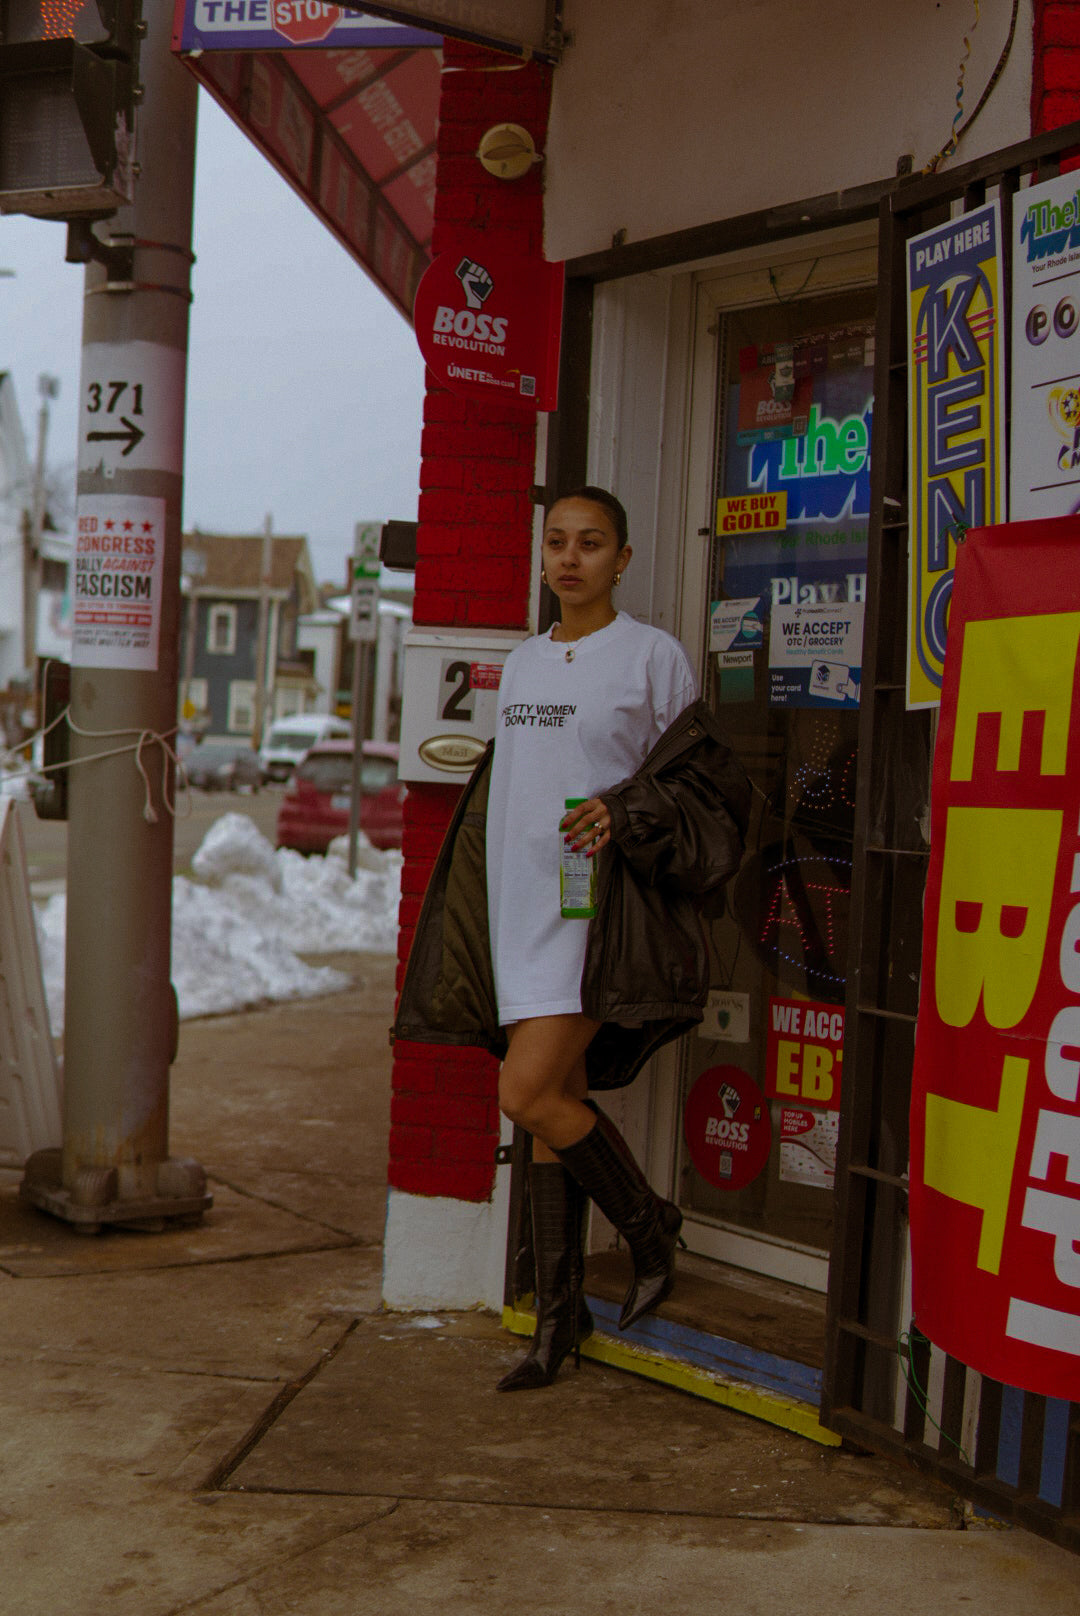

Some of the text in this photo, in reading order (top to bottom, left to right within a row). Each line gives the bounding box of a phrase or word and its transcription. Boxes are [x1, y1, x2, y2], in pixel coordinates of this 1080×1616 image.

[202, 0, 267, 22] THE
[915, 219, 991, 272] PLAY HERE
[432, 305, 509, 344] BOSS
[431, 333, 506, 357] REVOLUTION
[447, 362, 488, 383] ÚNETE
[86, 382, 143, 415] 371
[726, 495, 777, 513] WE BUY
[722, 510, 780, 532] GOLD
[77, 534, 155, 556] CONGRESS
[805, 530, 847, 546] Rhode
[76, 557, 155, 574] RALLY AGAINST
[76, 573, 152, 600] FASCISM
[782, 621, 851, 636] WE ACCEPT
[787, 638, 802, 646] OTC
[808, 637, 844, 646] GROCERY
[722, 653, 752, 664] Newport
[772, 674, 784, 682] Use
[442, 661, 472, 721] 2
[505, 714, 565, 728] DON'T HATE
[535, 704, 577, 717] WOMEN
[922, 611, 1080, 1276] EBT
[772, 1004, 801, 1035] WE
[705, 1115, 750, 1142] BOSS
[704, 1134, 749, 1152] REVOLUTION
